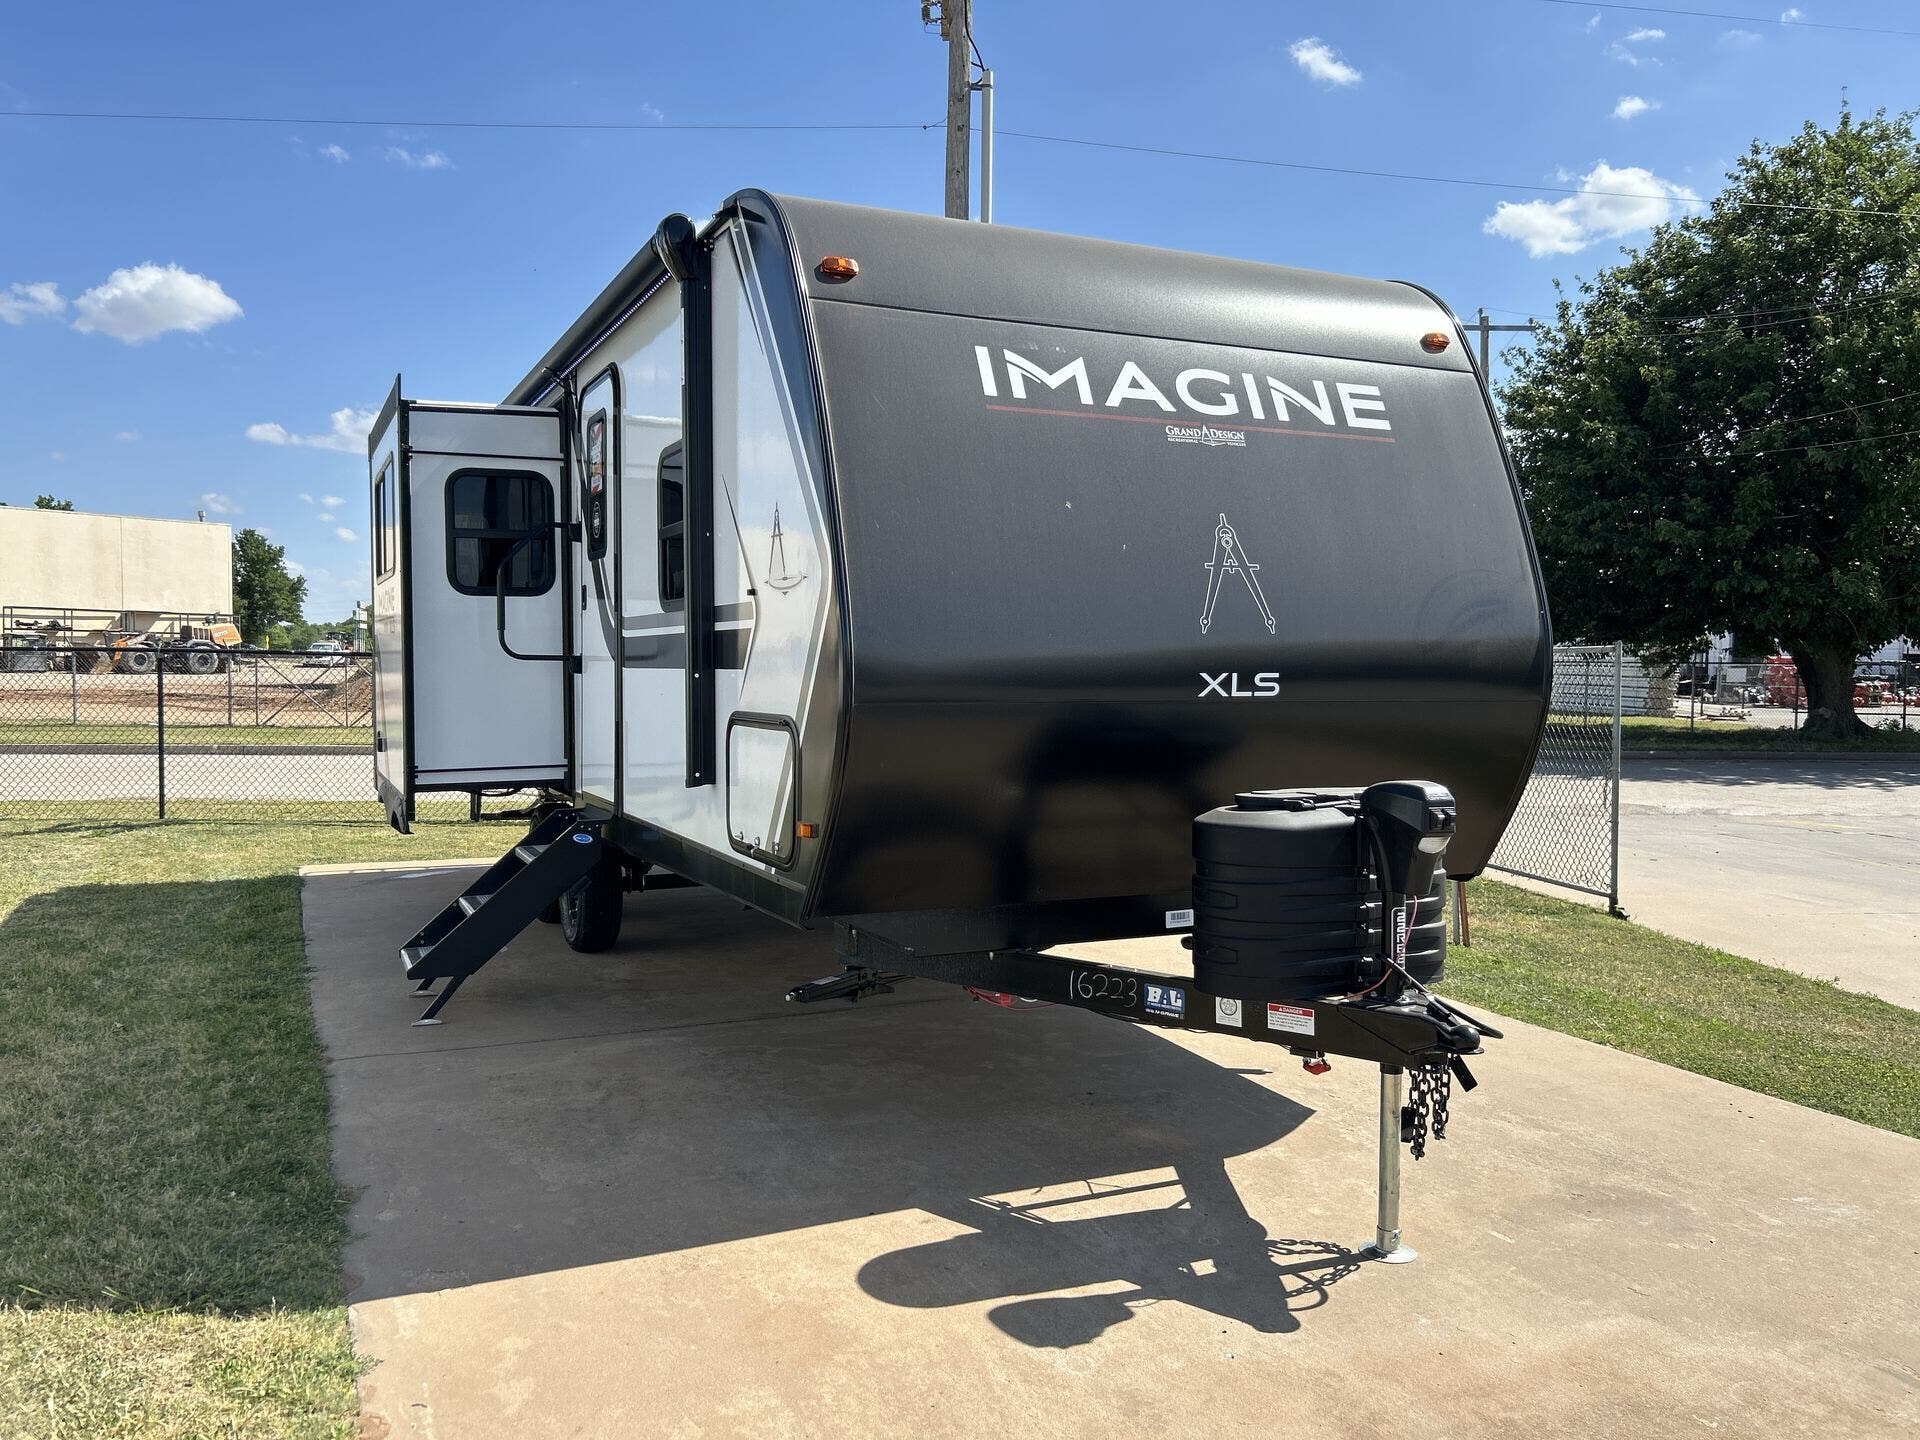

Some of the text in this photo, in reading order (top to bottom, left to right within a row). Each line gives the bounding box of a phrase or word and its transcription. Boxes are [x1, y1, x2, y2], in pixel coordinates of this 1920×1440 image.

[974, 345, 1391, 431] IMAGINE
[1165, 425, 1245, 440] GRAND DESIGN
[1197, 672, 1280, 697] XLS
[1069, 969, 1138, 1008] 16223
[1147, 986, 1182, 1007] BAL
